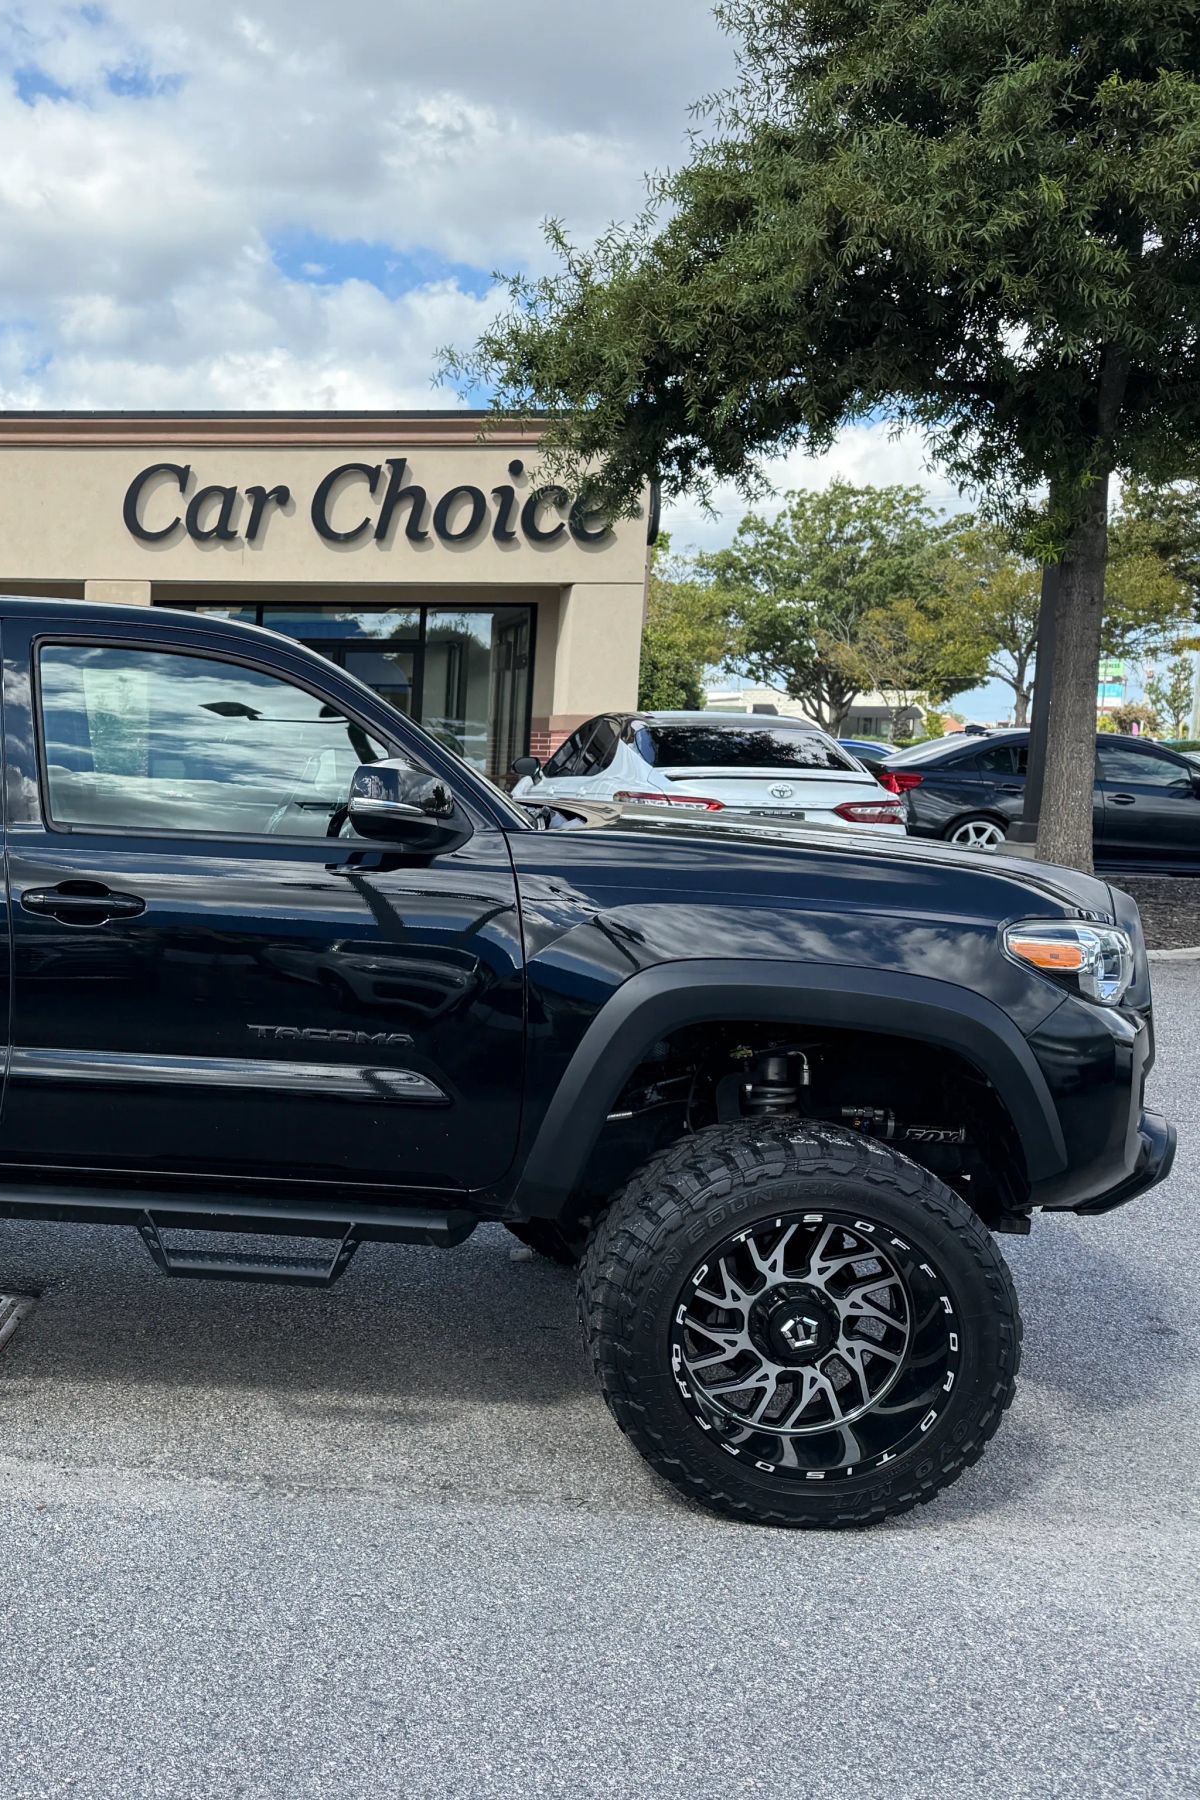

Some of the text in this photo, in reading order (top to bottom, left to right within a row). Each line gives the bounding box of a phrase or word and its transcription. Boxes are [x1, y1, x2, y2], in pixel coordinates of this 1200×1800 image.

[123, 462, 290, 542] Car
[246, 1023, 416, 1048] TACOMA
[905, 1128, 961, 1143] FOX
